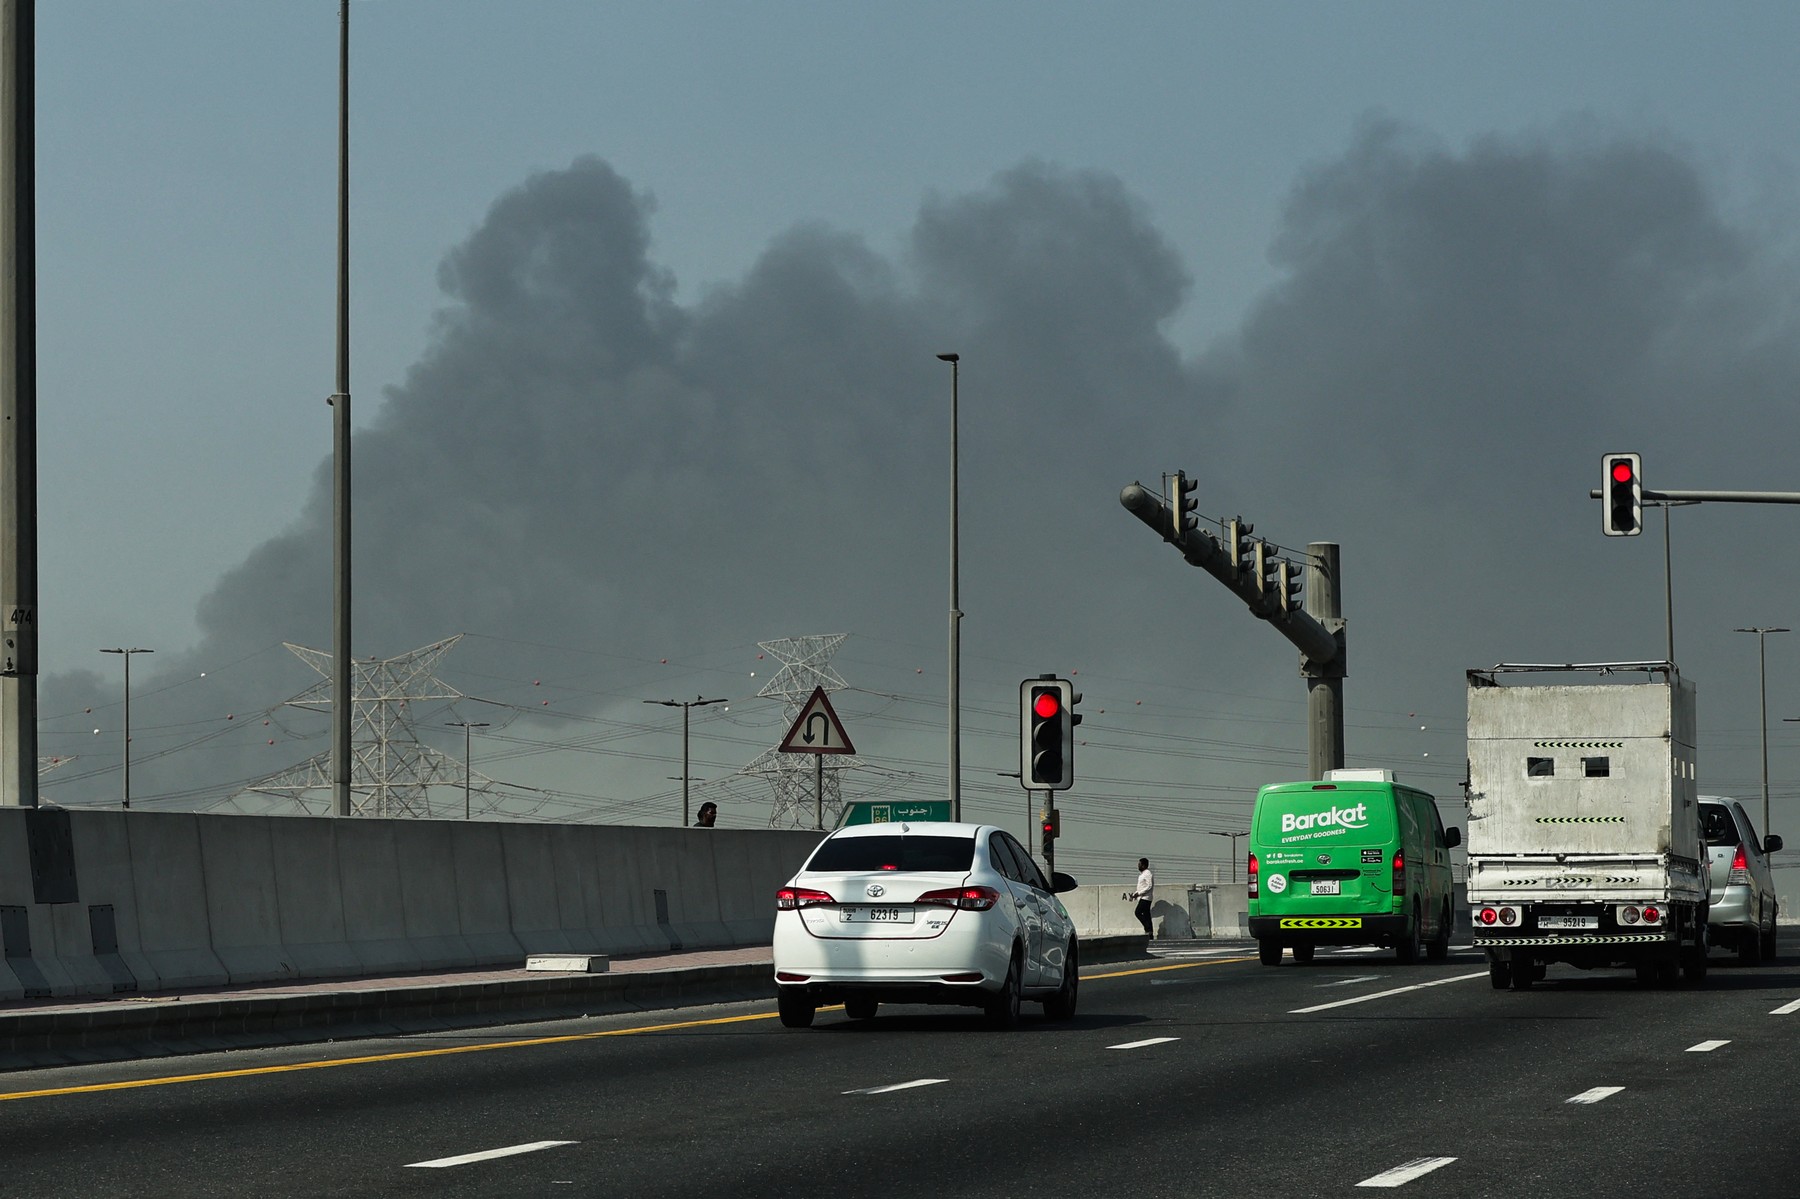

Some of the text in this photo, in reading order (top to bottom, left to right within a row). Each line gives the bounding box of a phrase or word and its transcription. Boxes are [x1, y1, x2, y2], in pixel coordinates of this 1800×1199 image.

[10, 608, 32, 625] 474
[1281, 803, 1369, 832] Barakat
[1281, 828, 1347, 844] EVERYDAY GOODNESS
[1315, 885, 1334, 894] 50631
[846, 913, 853, 921] Z
[870, 908, 899, 921] 62319
[1563, 917, 1586, 928] 95219
